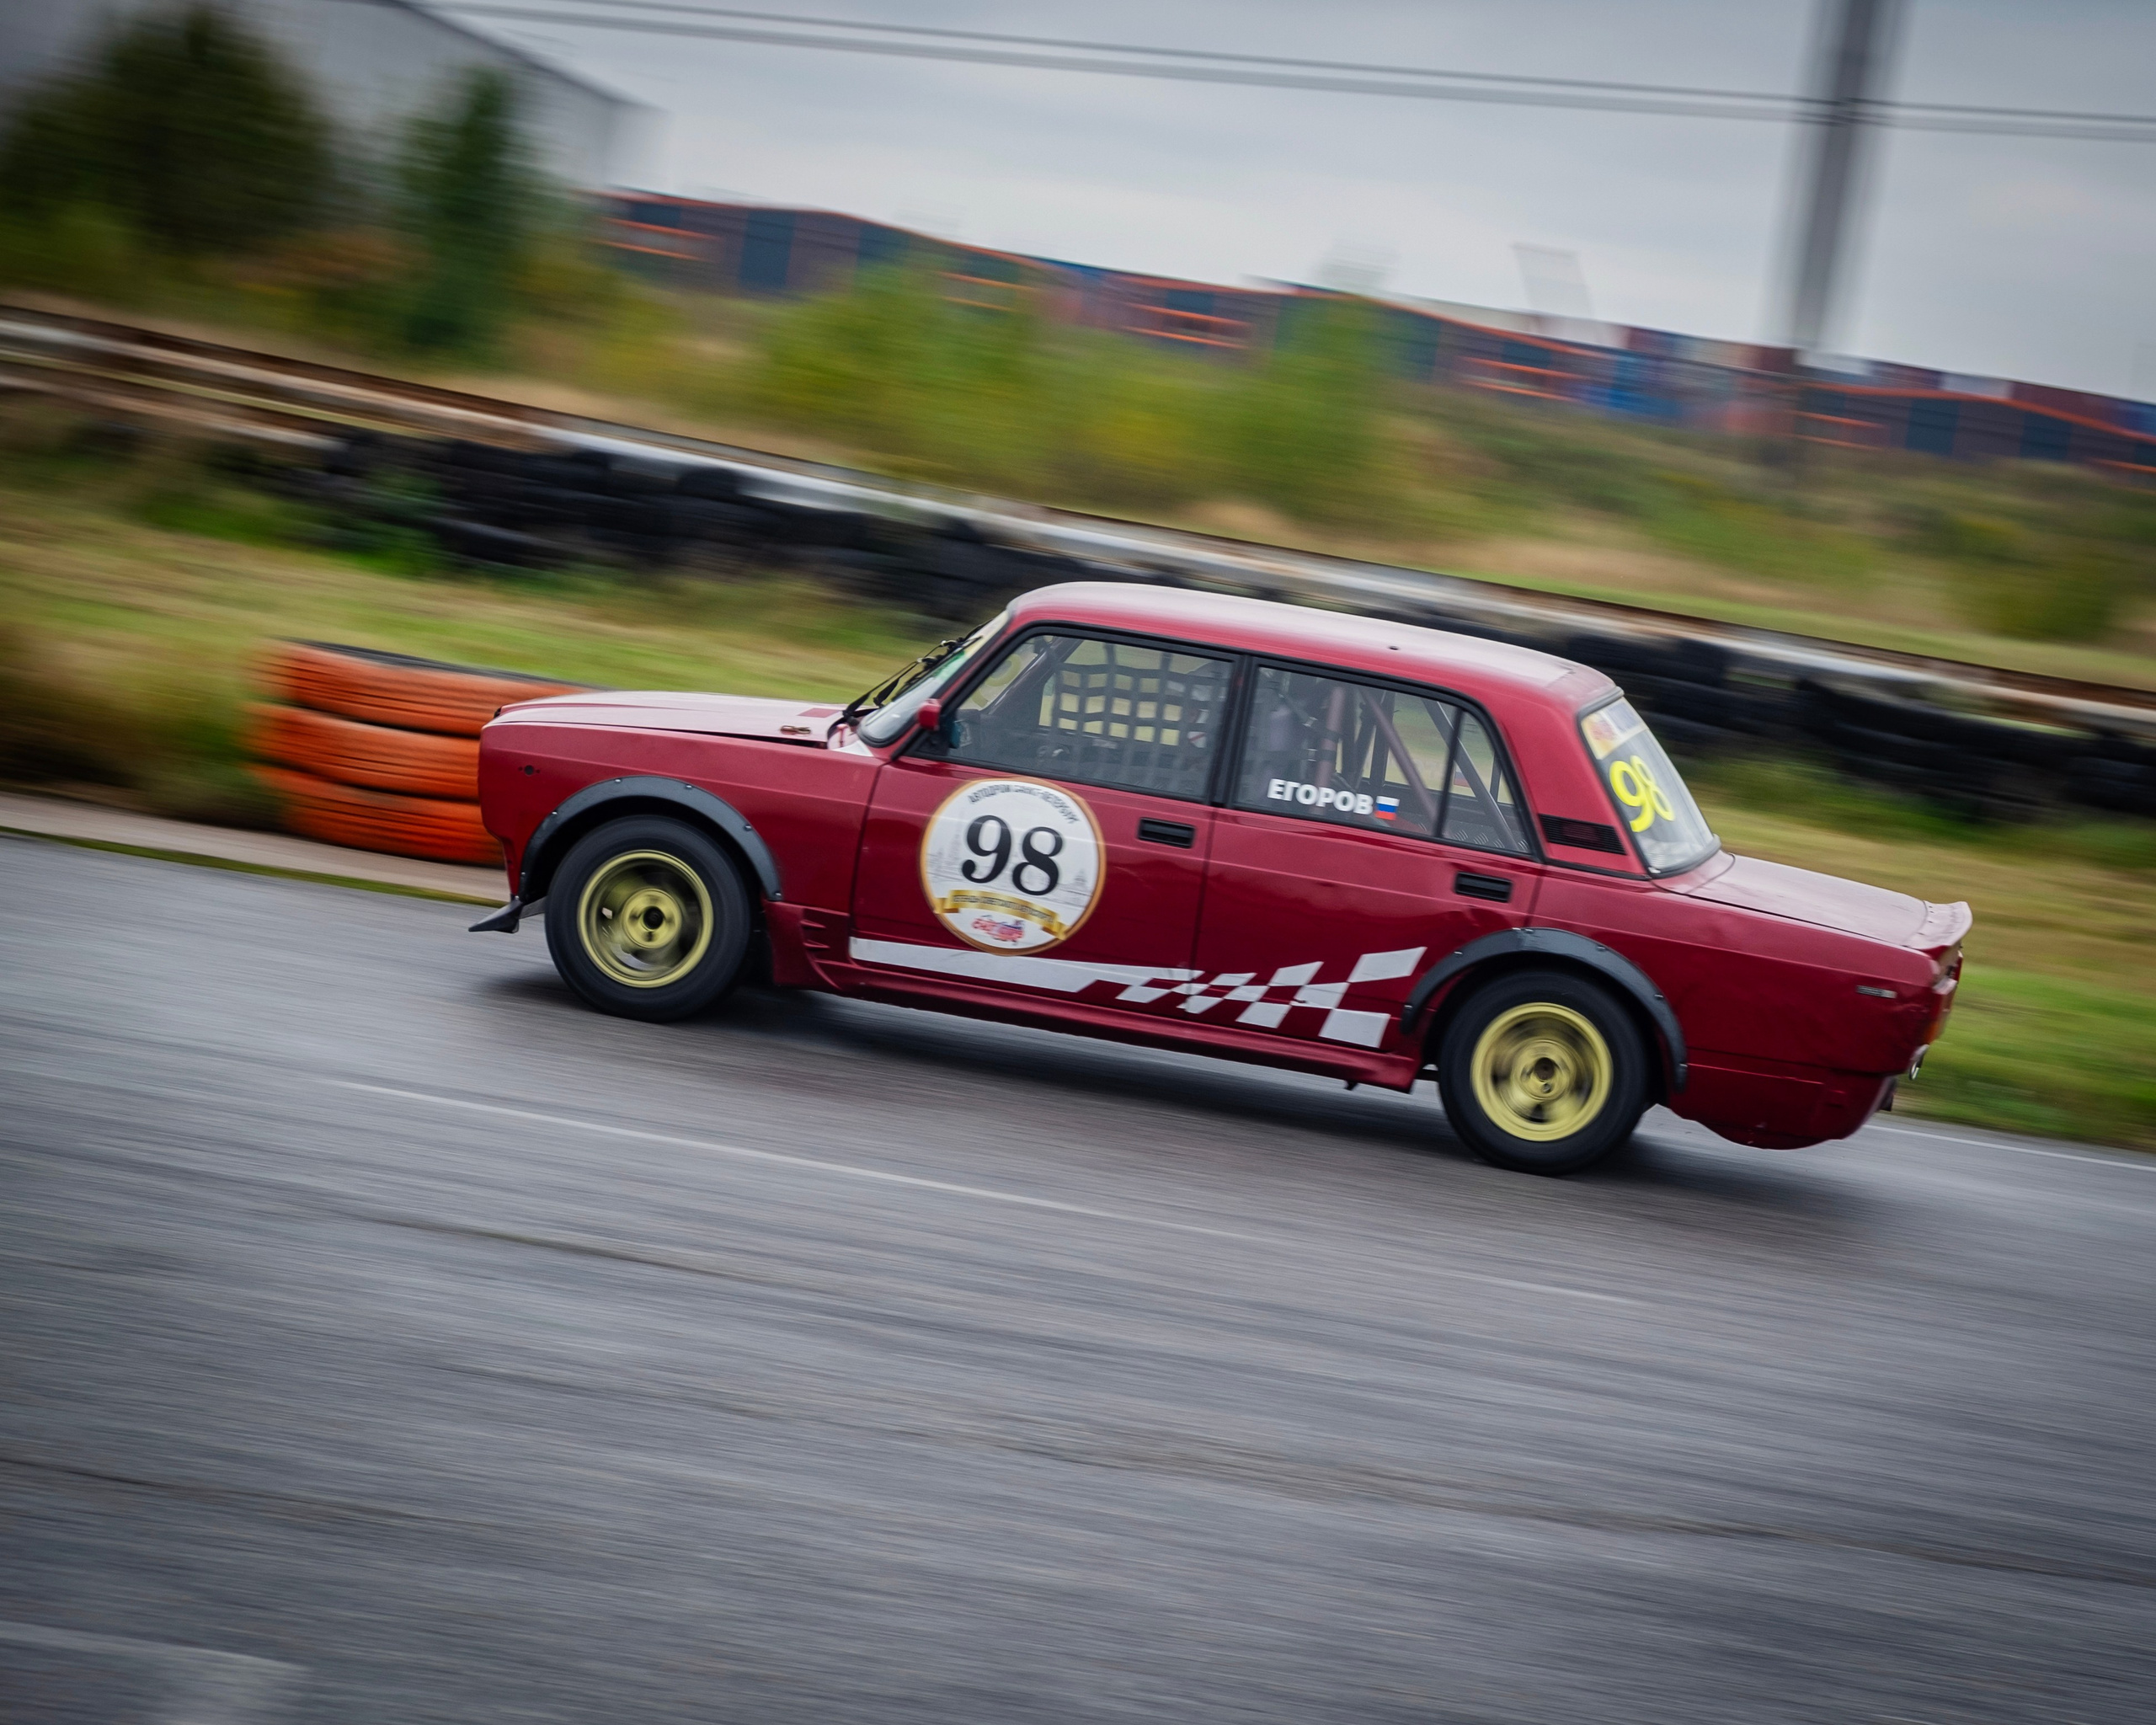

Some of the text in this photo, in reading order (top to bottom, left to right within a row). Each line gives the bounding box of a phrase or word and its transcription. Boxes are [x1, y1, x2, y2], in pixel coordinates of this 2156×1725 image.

[1267, 778, 1374, 815] ЕГОРОВ
[1609, 755, 1675, 832] 98
[962, 814, 1063, 896] 98
